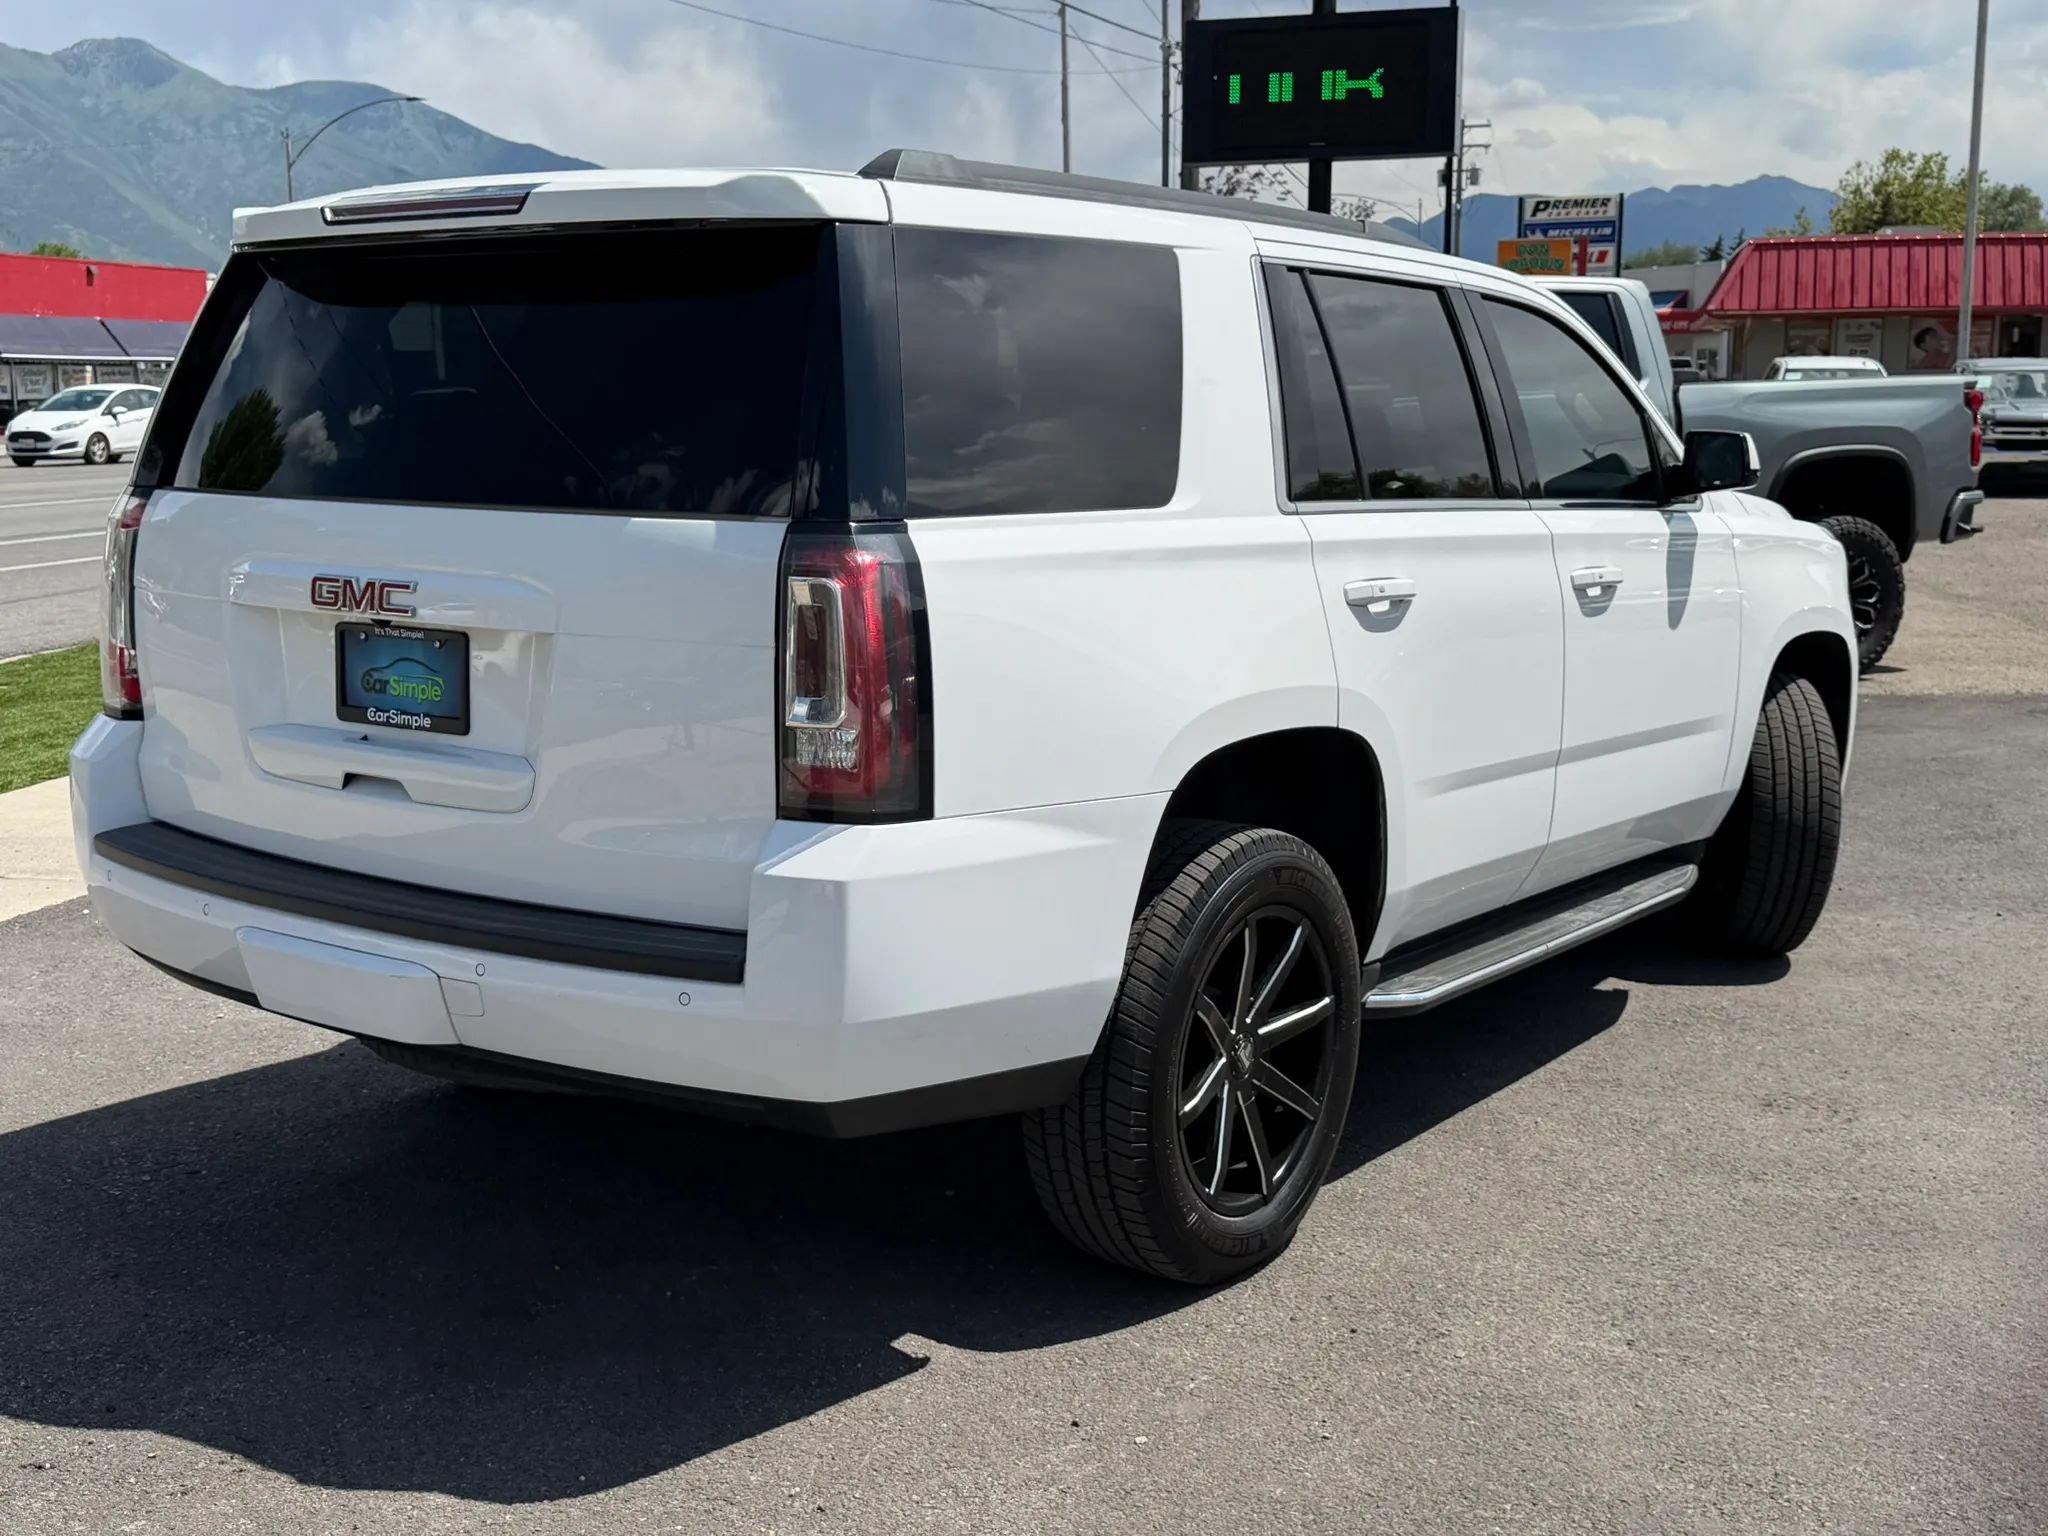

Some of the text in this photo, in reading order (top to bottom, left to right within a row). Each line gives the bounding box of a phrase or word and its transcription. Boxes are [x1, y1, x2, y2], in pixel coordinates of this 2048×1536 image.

[1530, 198, 1612, 217] PREMIER
[1547, 227, 1612, 238] MICHELIN
[311, 573, 417, 617] GMC
[385, 628, 400, 638] That
[361, 671, 442, 702] CarSimple
[367, 707, 431, 729] CarSimple
